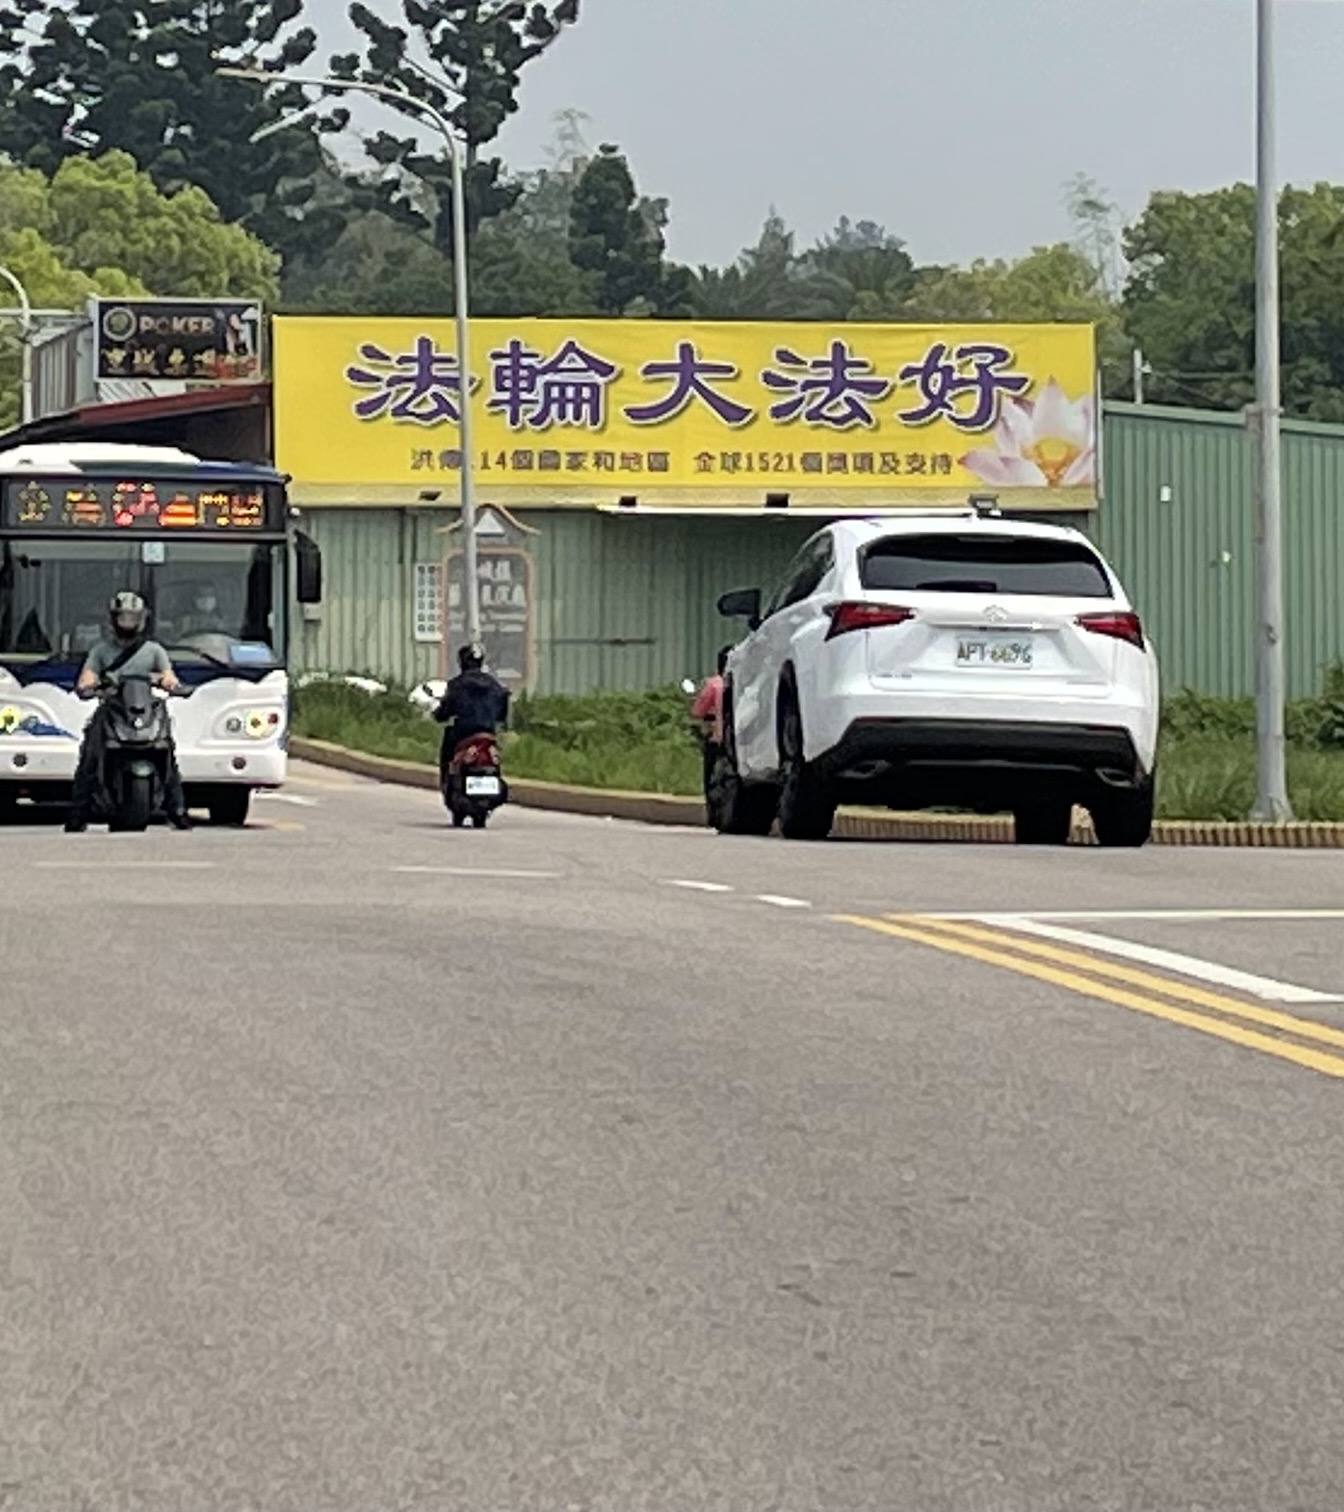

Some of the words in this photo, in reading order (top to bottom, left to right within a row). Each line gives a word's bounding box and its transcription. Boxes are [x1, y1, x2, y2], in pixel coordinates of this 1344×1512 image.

[345, 336, 1028, 429] 法輪大法好
[410, 448, 670, 473] 洪傳14個國家和地區
